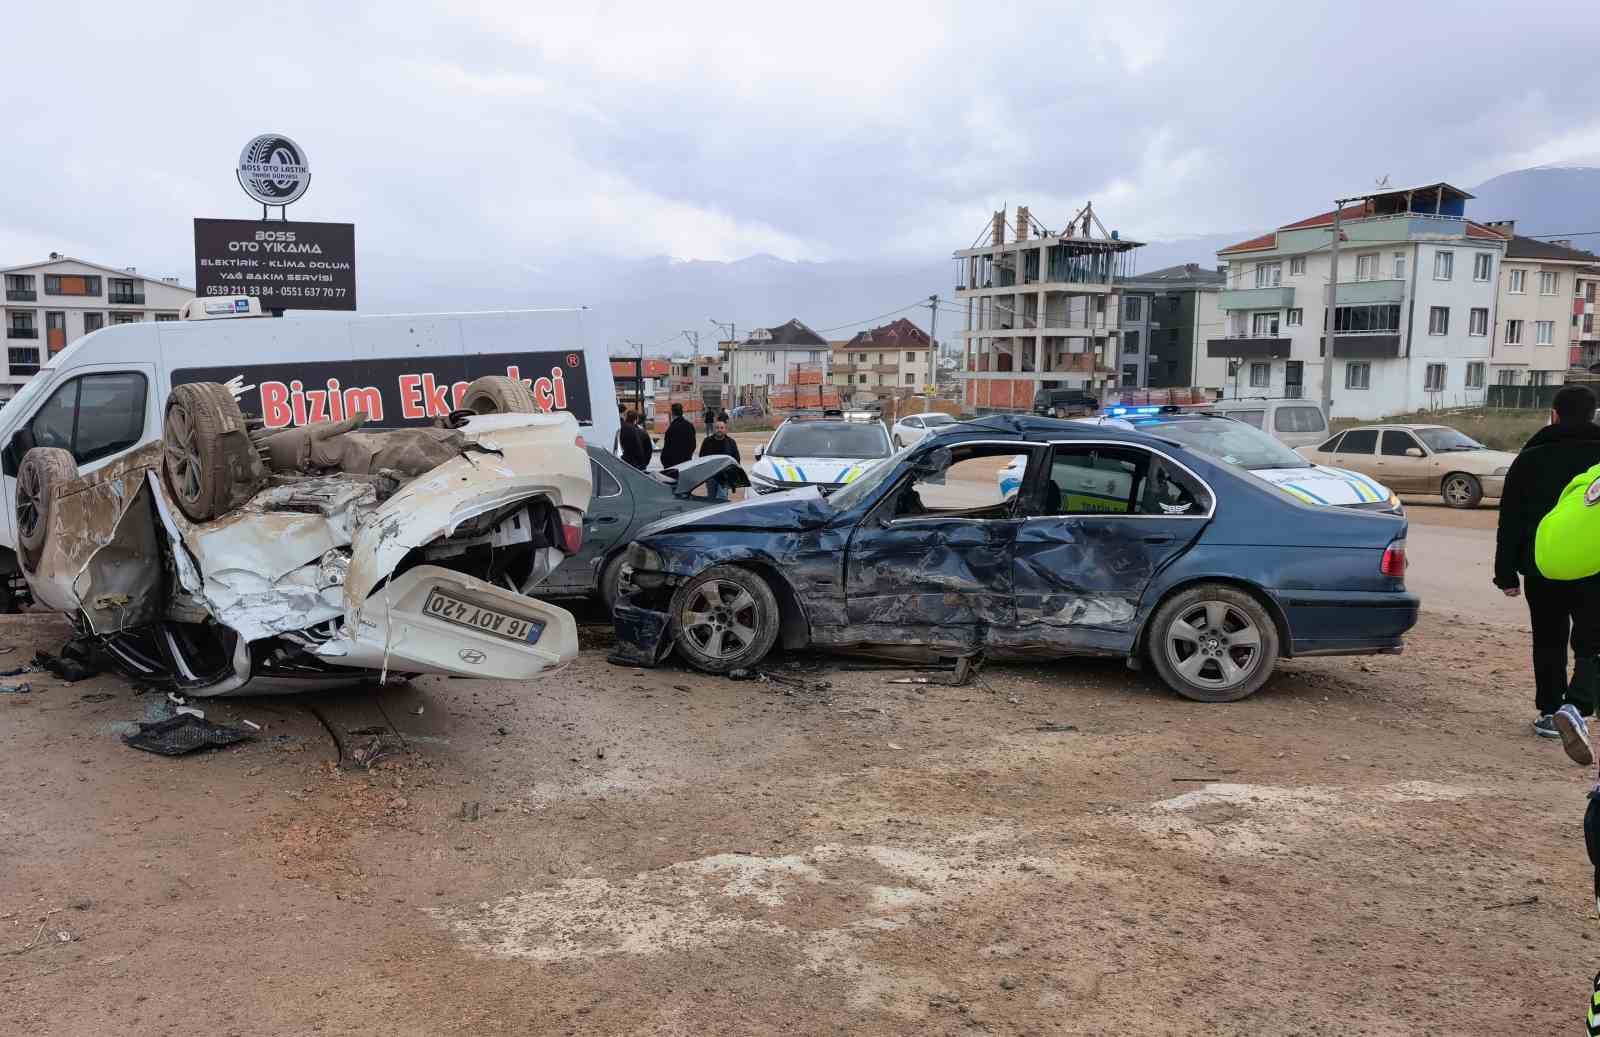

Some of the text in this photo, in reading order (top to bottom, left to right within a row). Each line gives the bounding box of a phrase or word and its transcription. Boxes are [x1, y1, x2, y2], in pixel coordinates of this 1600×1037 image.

[255, 230, 296, 242] BOSS
[228, 241, 323, 254] OTO YIKAMA
[269, 259, 306, 268] KLİMA
[308, 261, 350, 270] DOLUM
[219, 270, 243, 280] YAĞ
[246, 272, 284, 281] BAKIM
[206, 285, 229, 295] 0539
[231, 285, 247, 295] 211
[249, 286, 260, 295] 33
[262, 286, 273, 296] 84
[281, 286, 302, 296] 0551
[304, 287, 320, 296] 637
[322, 287, 334, 297] 70
[335, 288, 346, 297] 77
[260, 377, 384, 427] Bizim
[431, 597, 528, 638] 16 AOY 420
